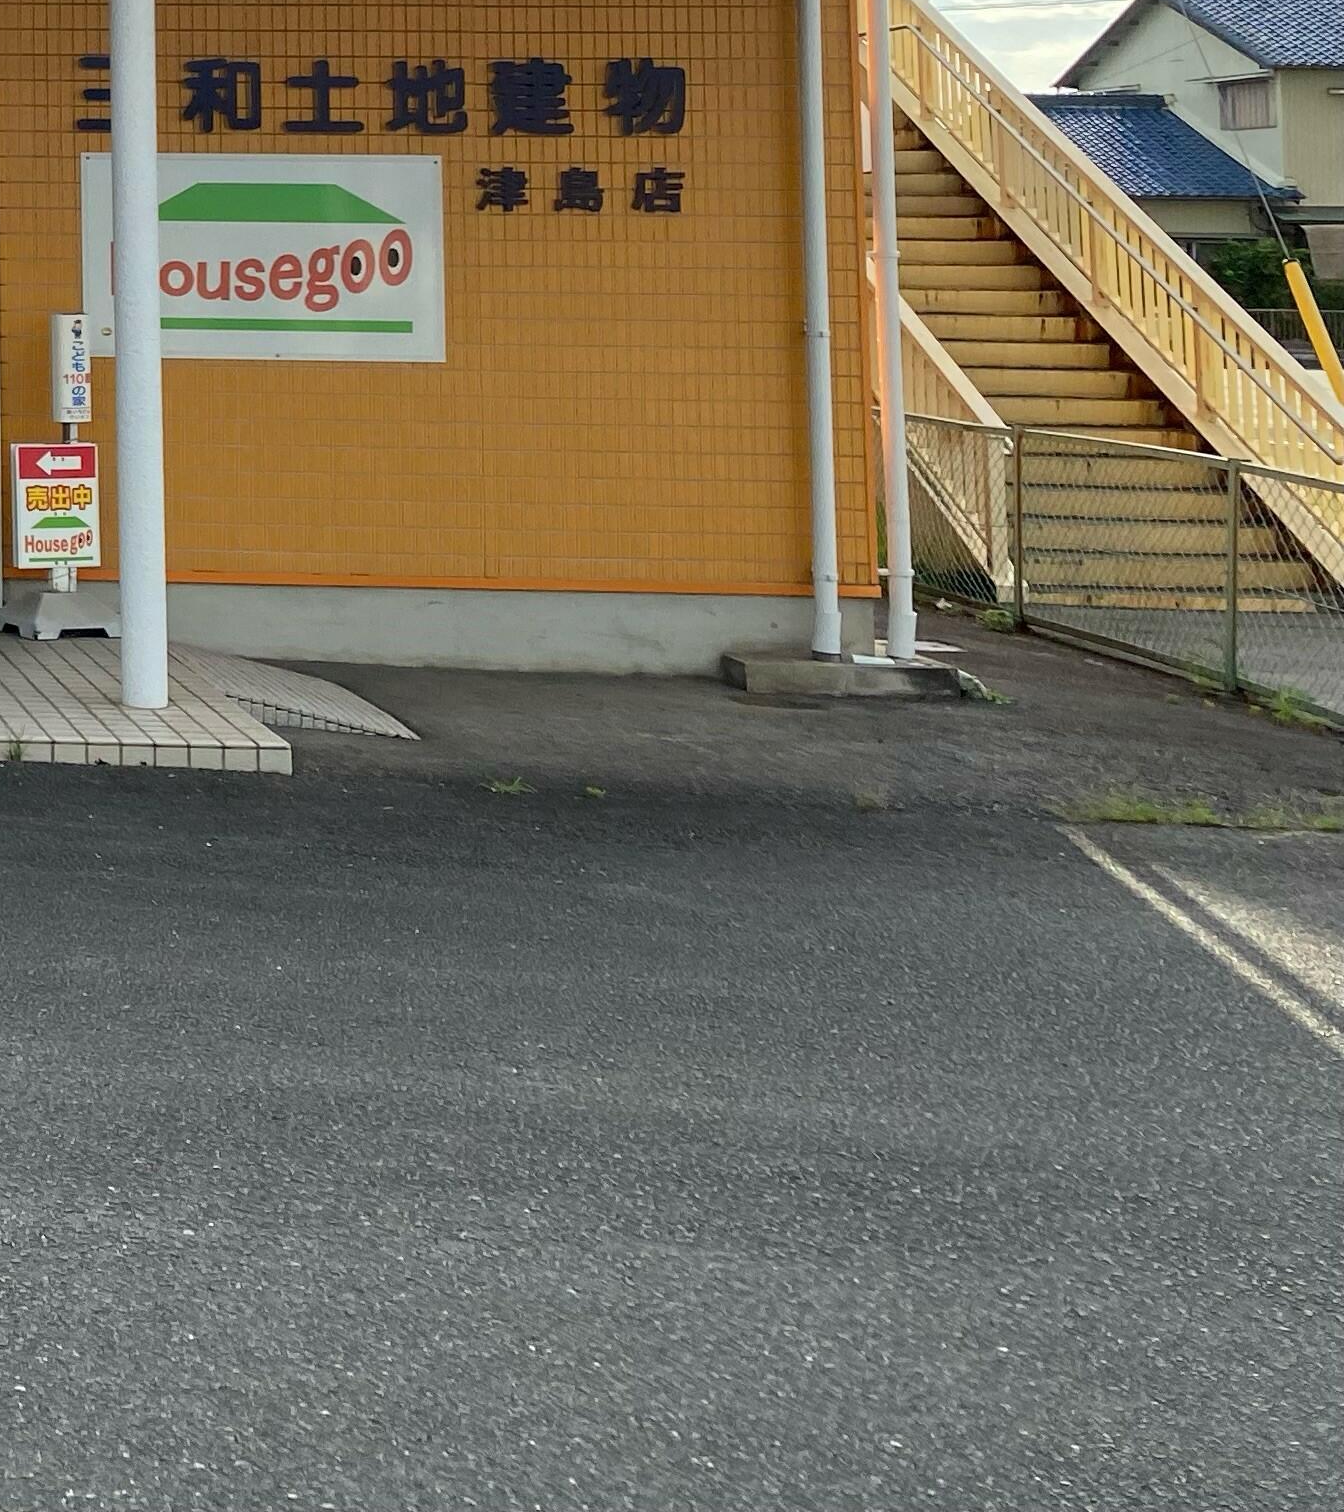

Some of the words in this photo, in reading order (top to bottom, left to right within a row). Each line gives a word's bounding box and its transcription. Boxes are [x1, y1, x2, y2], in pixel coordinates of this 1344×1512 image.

[476, 166, 684, 213] 津島店
[110, 228, 413, 312] ousegoo
[25, 484, 93, 512] 売出中
